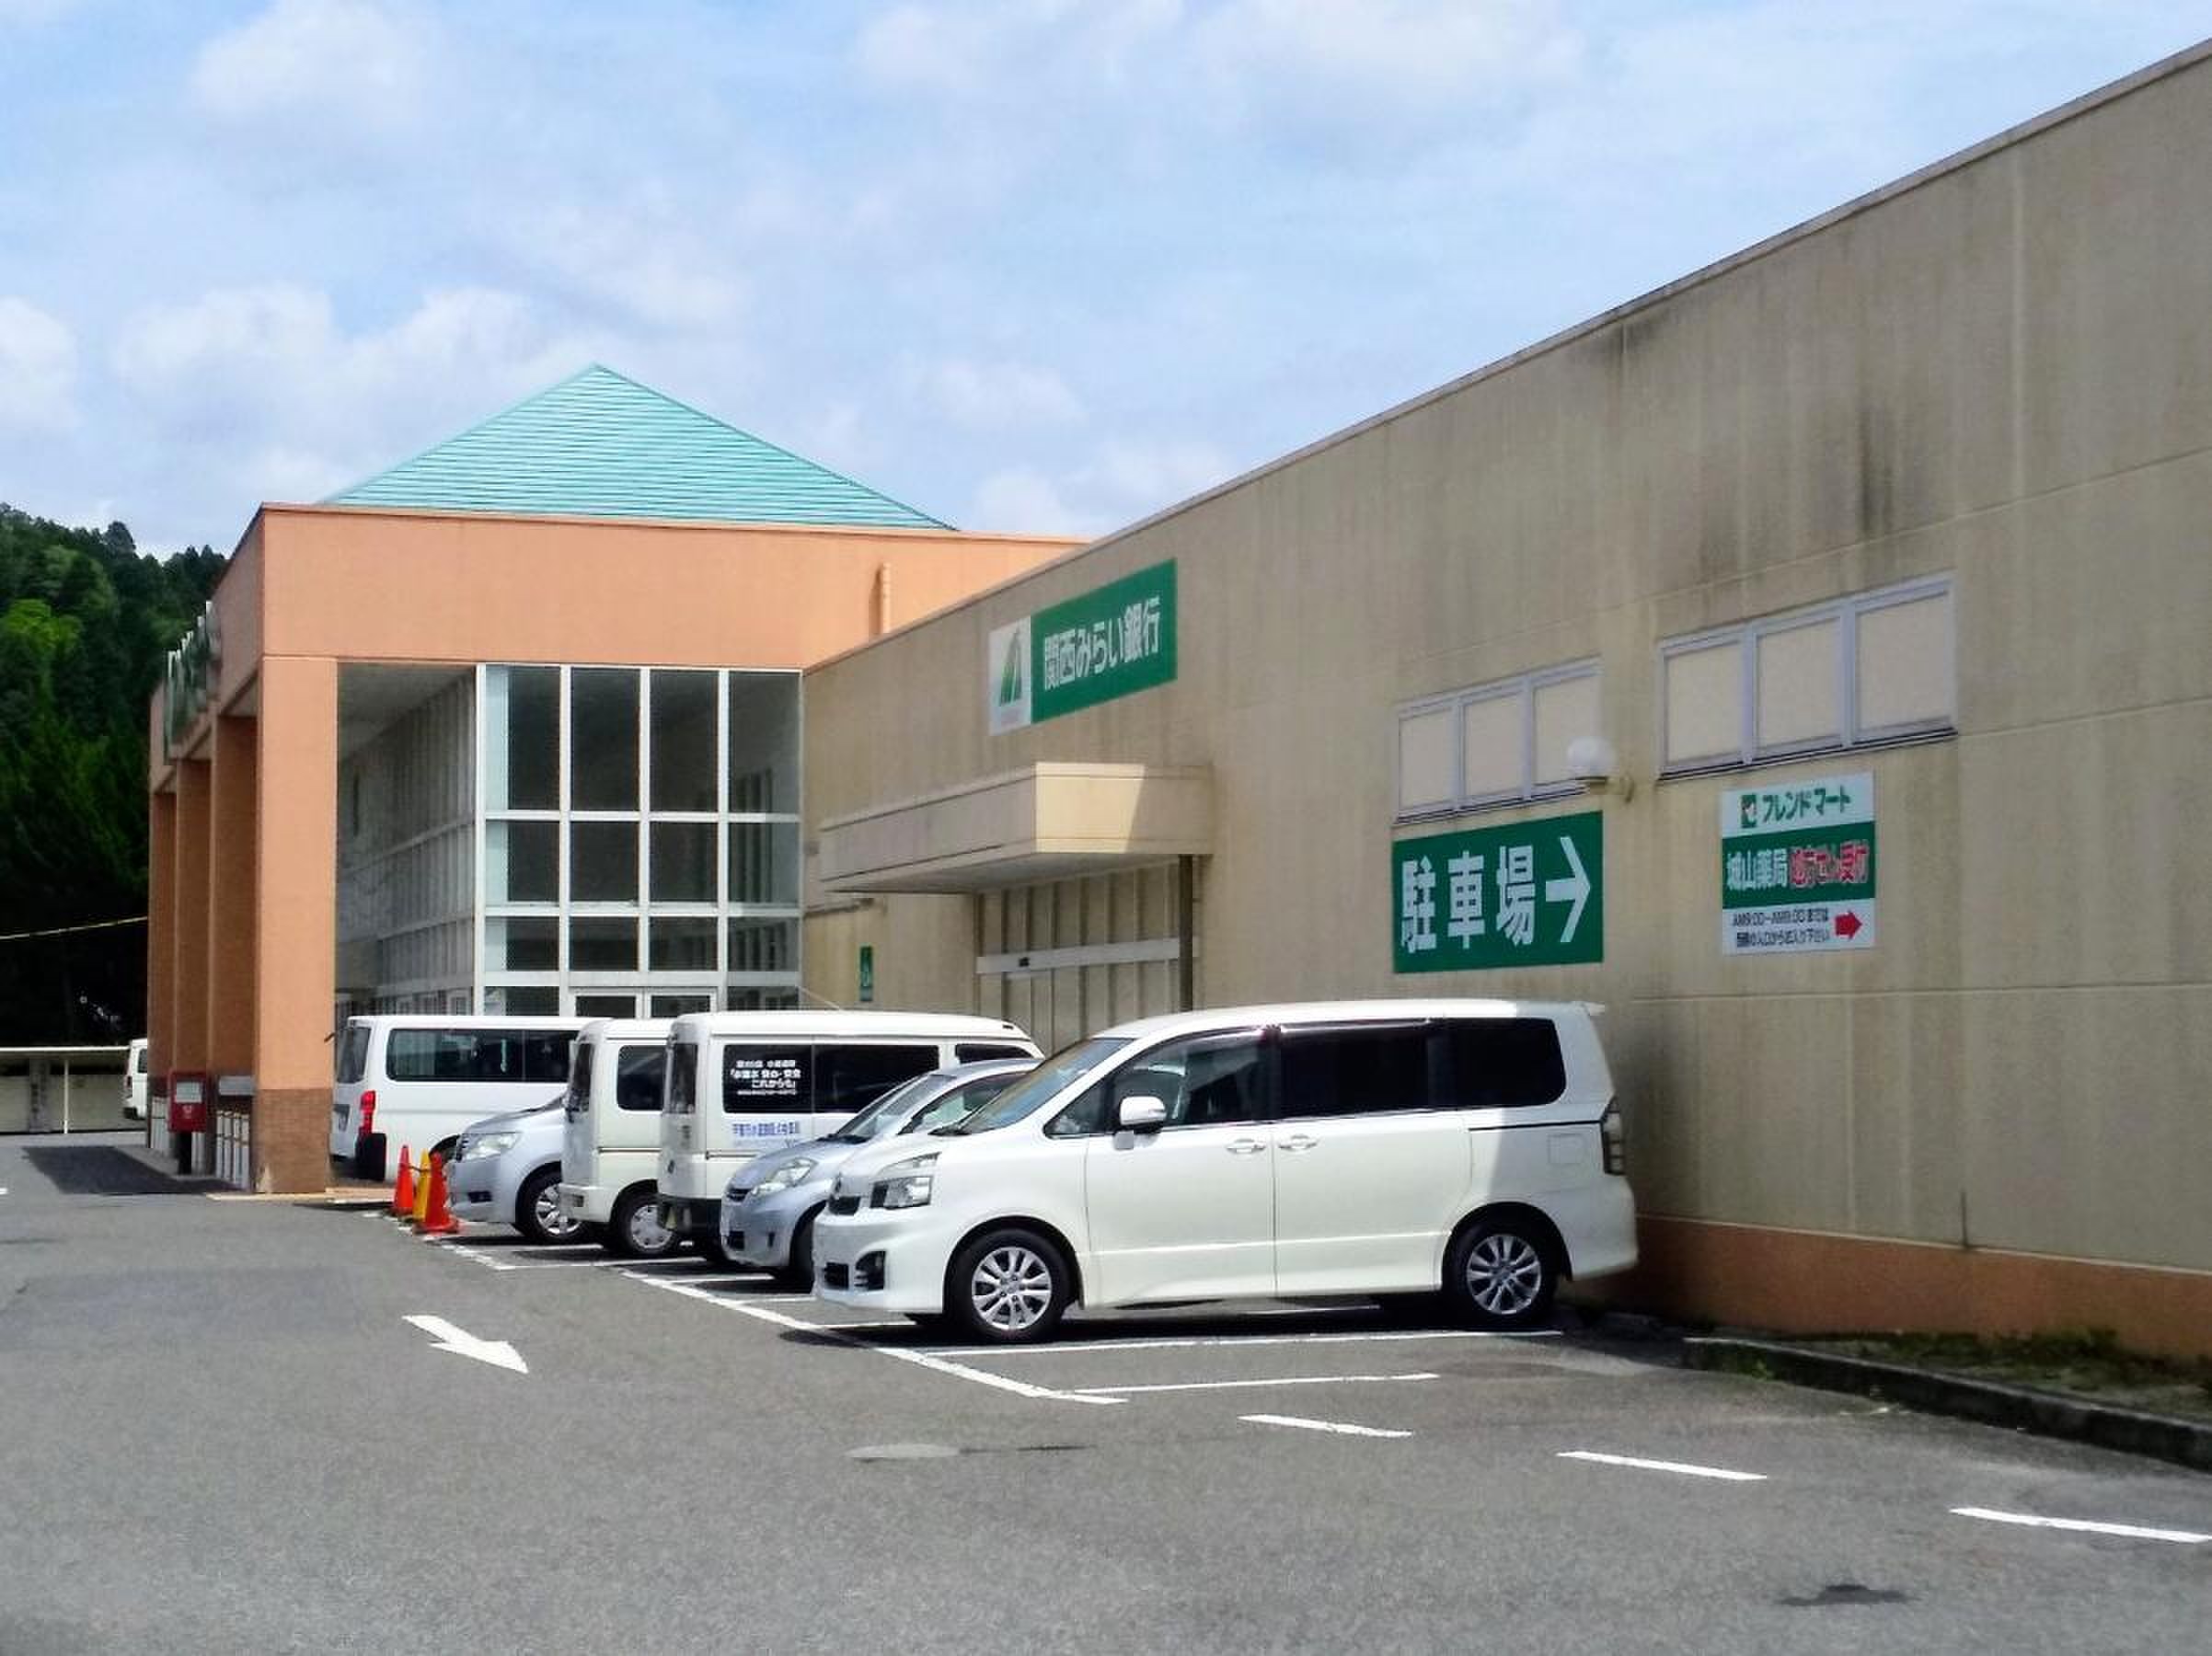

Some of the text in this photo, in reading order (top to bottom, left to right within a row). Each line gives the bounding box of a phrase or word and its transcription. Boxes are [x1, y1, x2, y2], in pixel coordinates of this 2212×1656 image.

[1043, 594, 1161, 691] 関西みらい銀行
[1761, 784, 1851, 823] フレンドマート
[1401, 845, 1537, 954] 駐車場
